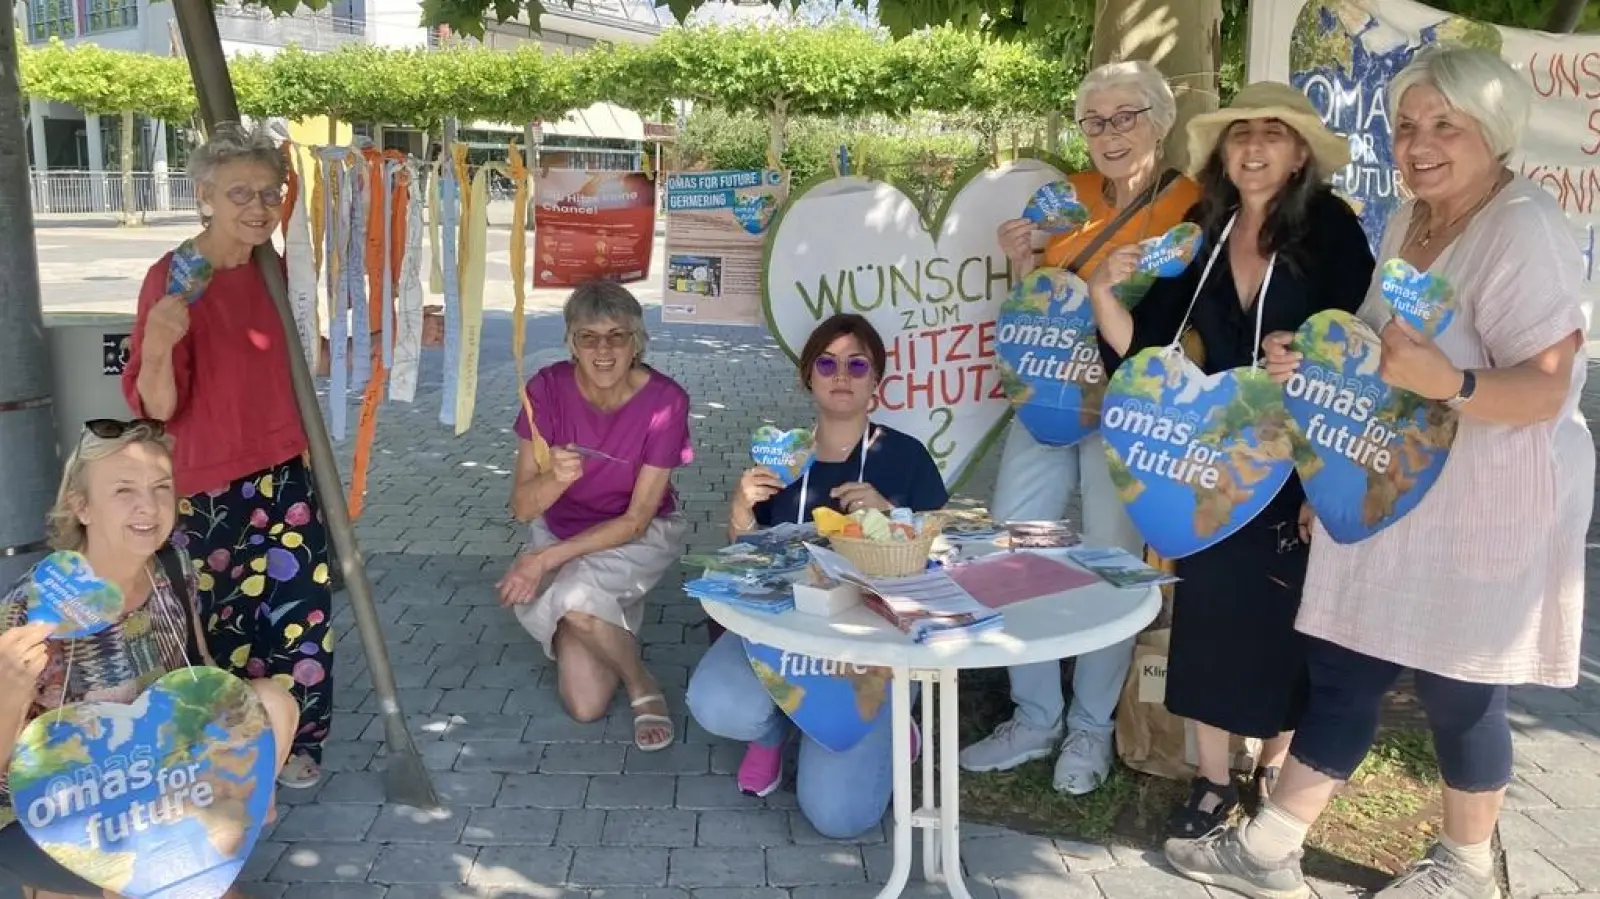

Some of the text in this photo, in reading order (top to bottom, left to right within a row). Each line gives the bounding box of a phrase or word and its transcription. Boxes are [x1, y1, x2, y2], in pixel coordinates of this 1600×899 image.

[1334, 132, 1379, 165] OR
[668, 172, 758, 190] OMAS FOR FUTURE
[670, 193, 726, 208] GERMERING
[1382, 280, 1418, 300] omas
[901, 304, 961, 330] ZUM
[1394, 297, 1431, 320] future
[999, 322, 1077, 350] omas
[1016, 350, 1102, 384] future
[867, 363, 1008, 415] CHUTZ
[1286, 372, 1397, 446] omas for
[751, 445, 783, 456] omas
[1104, 405, 1193, 446] omas
[1184, 439, 1222, 466] for
[1305, 413, 1392, 474] future
[762, 454, 797, 467] future
[1125, 440, 1220, 489] future
[27, 759, 201, 828] omas for
[86, 780, 214, 850] future
